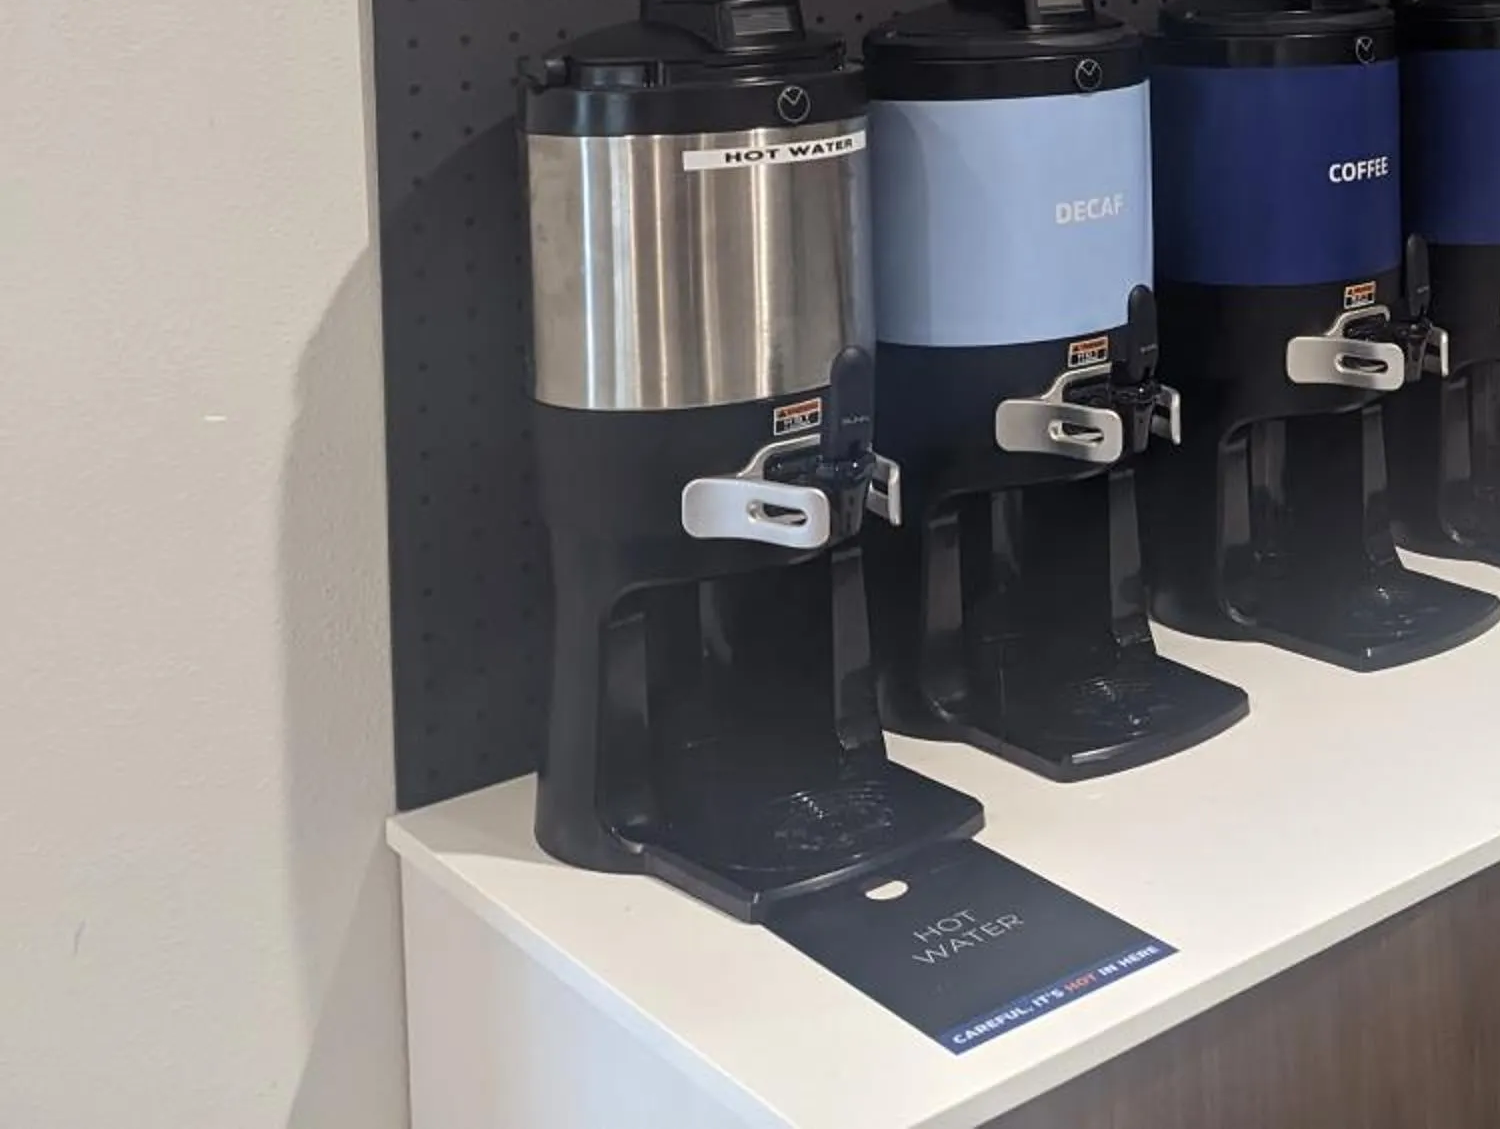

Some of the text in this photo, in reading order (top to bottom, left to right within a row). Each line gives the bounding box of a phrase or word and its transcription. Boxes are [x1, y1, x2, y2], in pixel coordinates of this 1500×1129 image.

[724, 138, 853, 163] HOT WATER
[1328, 156, 1389, 183] COFFEE
[1055, 193, 1124, 225] DECAF
[911, 912, 1025, 966] WATER
[913, 909, 978, 944] HOT
[1032, 988, 1065, 1008] IT'S
[1064, 973, 1098, 992] HOT
[1098, 963, 1119, 976] IN
[1118, 945, 1160, 968] HERE
